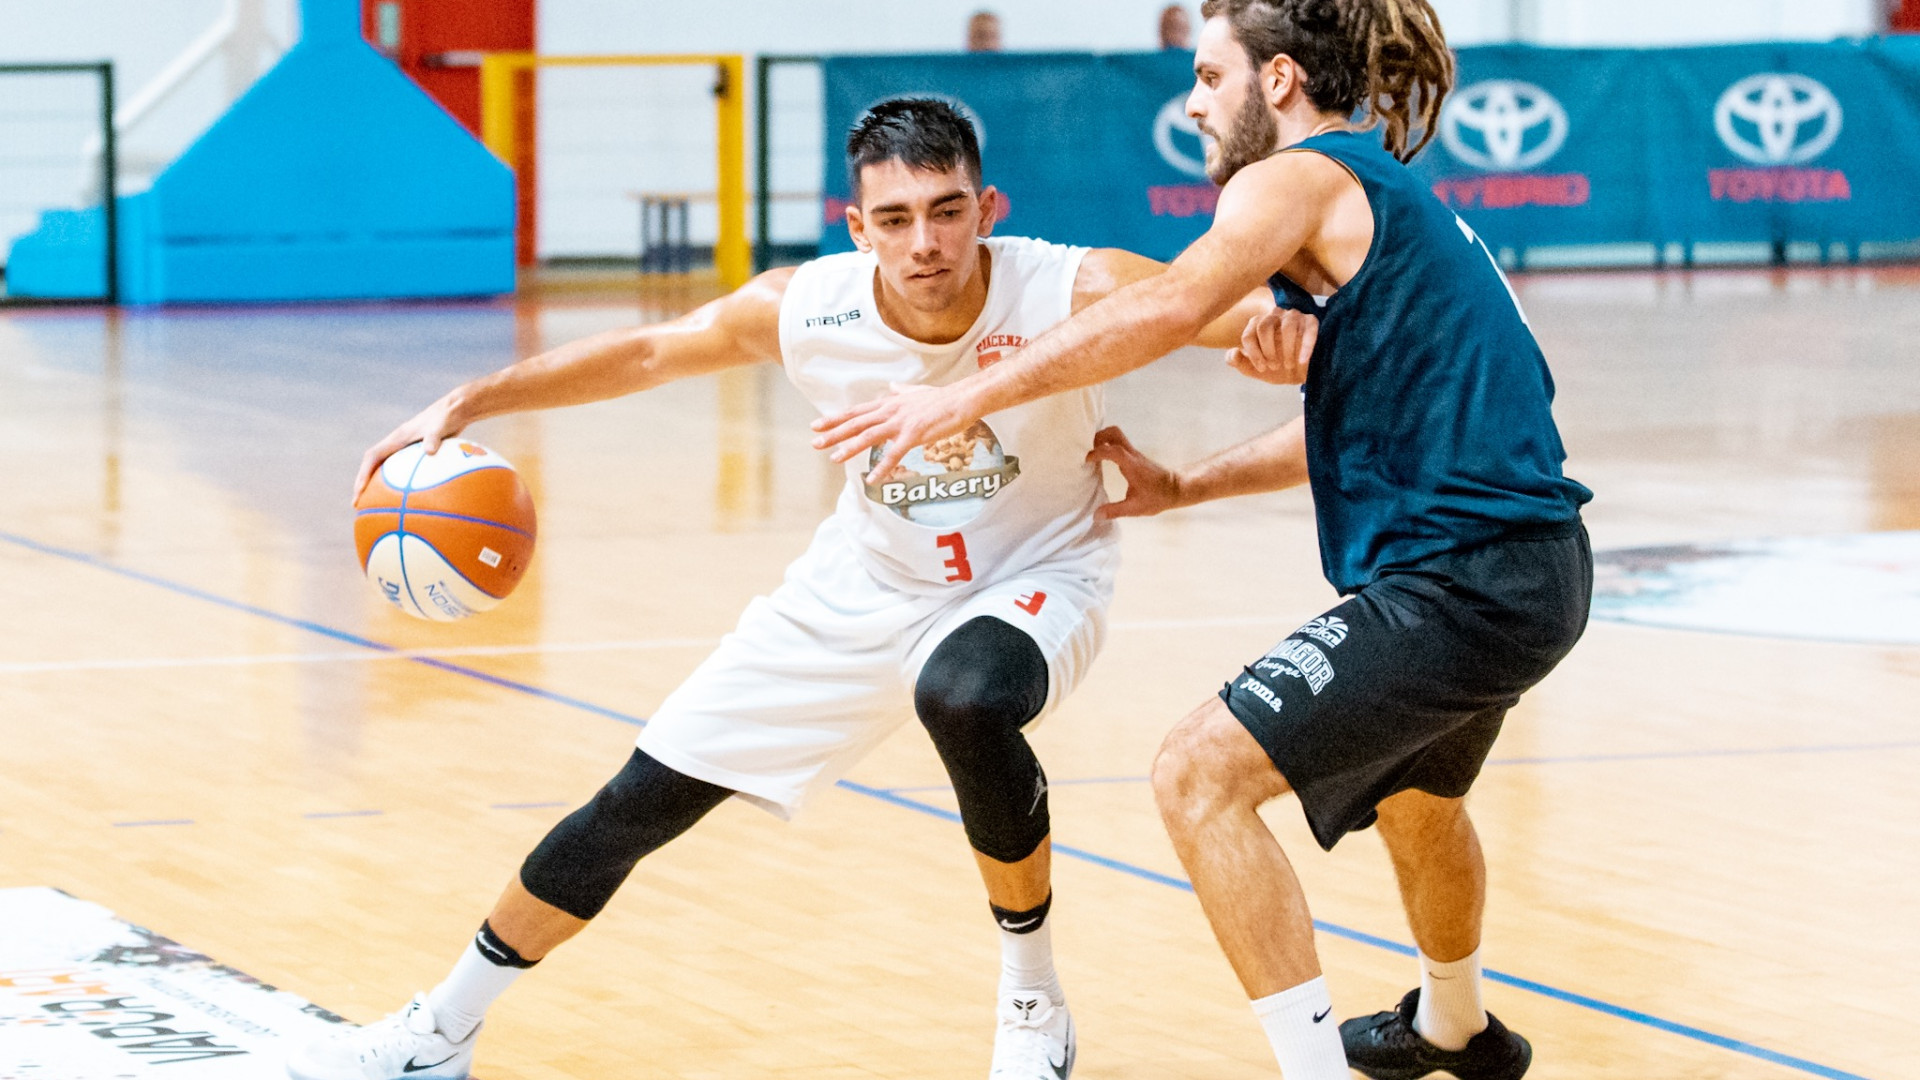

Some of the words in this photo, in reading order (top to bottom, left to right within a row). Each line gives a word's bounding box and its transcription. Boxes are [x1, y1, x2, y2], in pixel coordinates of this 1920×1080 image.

[1708, 167, 1850, 202] TOYOTA
[805, 309, 861, 328] maps
[881, 471, 1001, 505] Bakery
[936, 531, 973, 583] 3
[1265, 638, 1335, 696] LGOR
